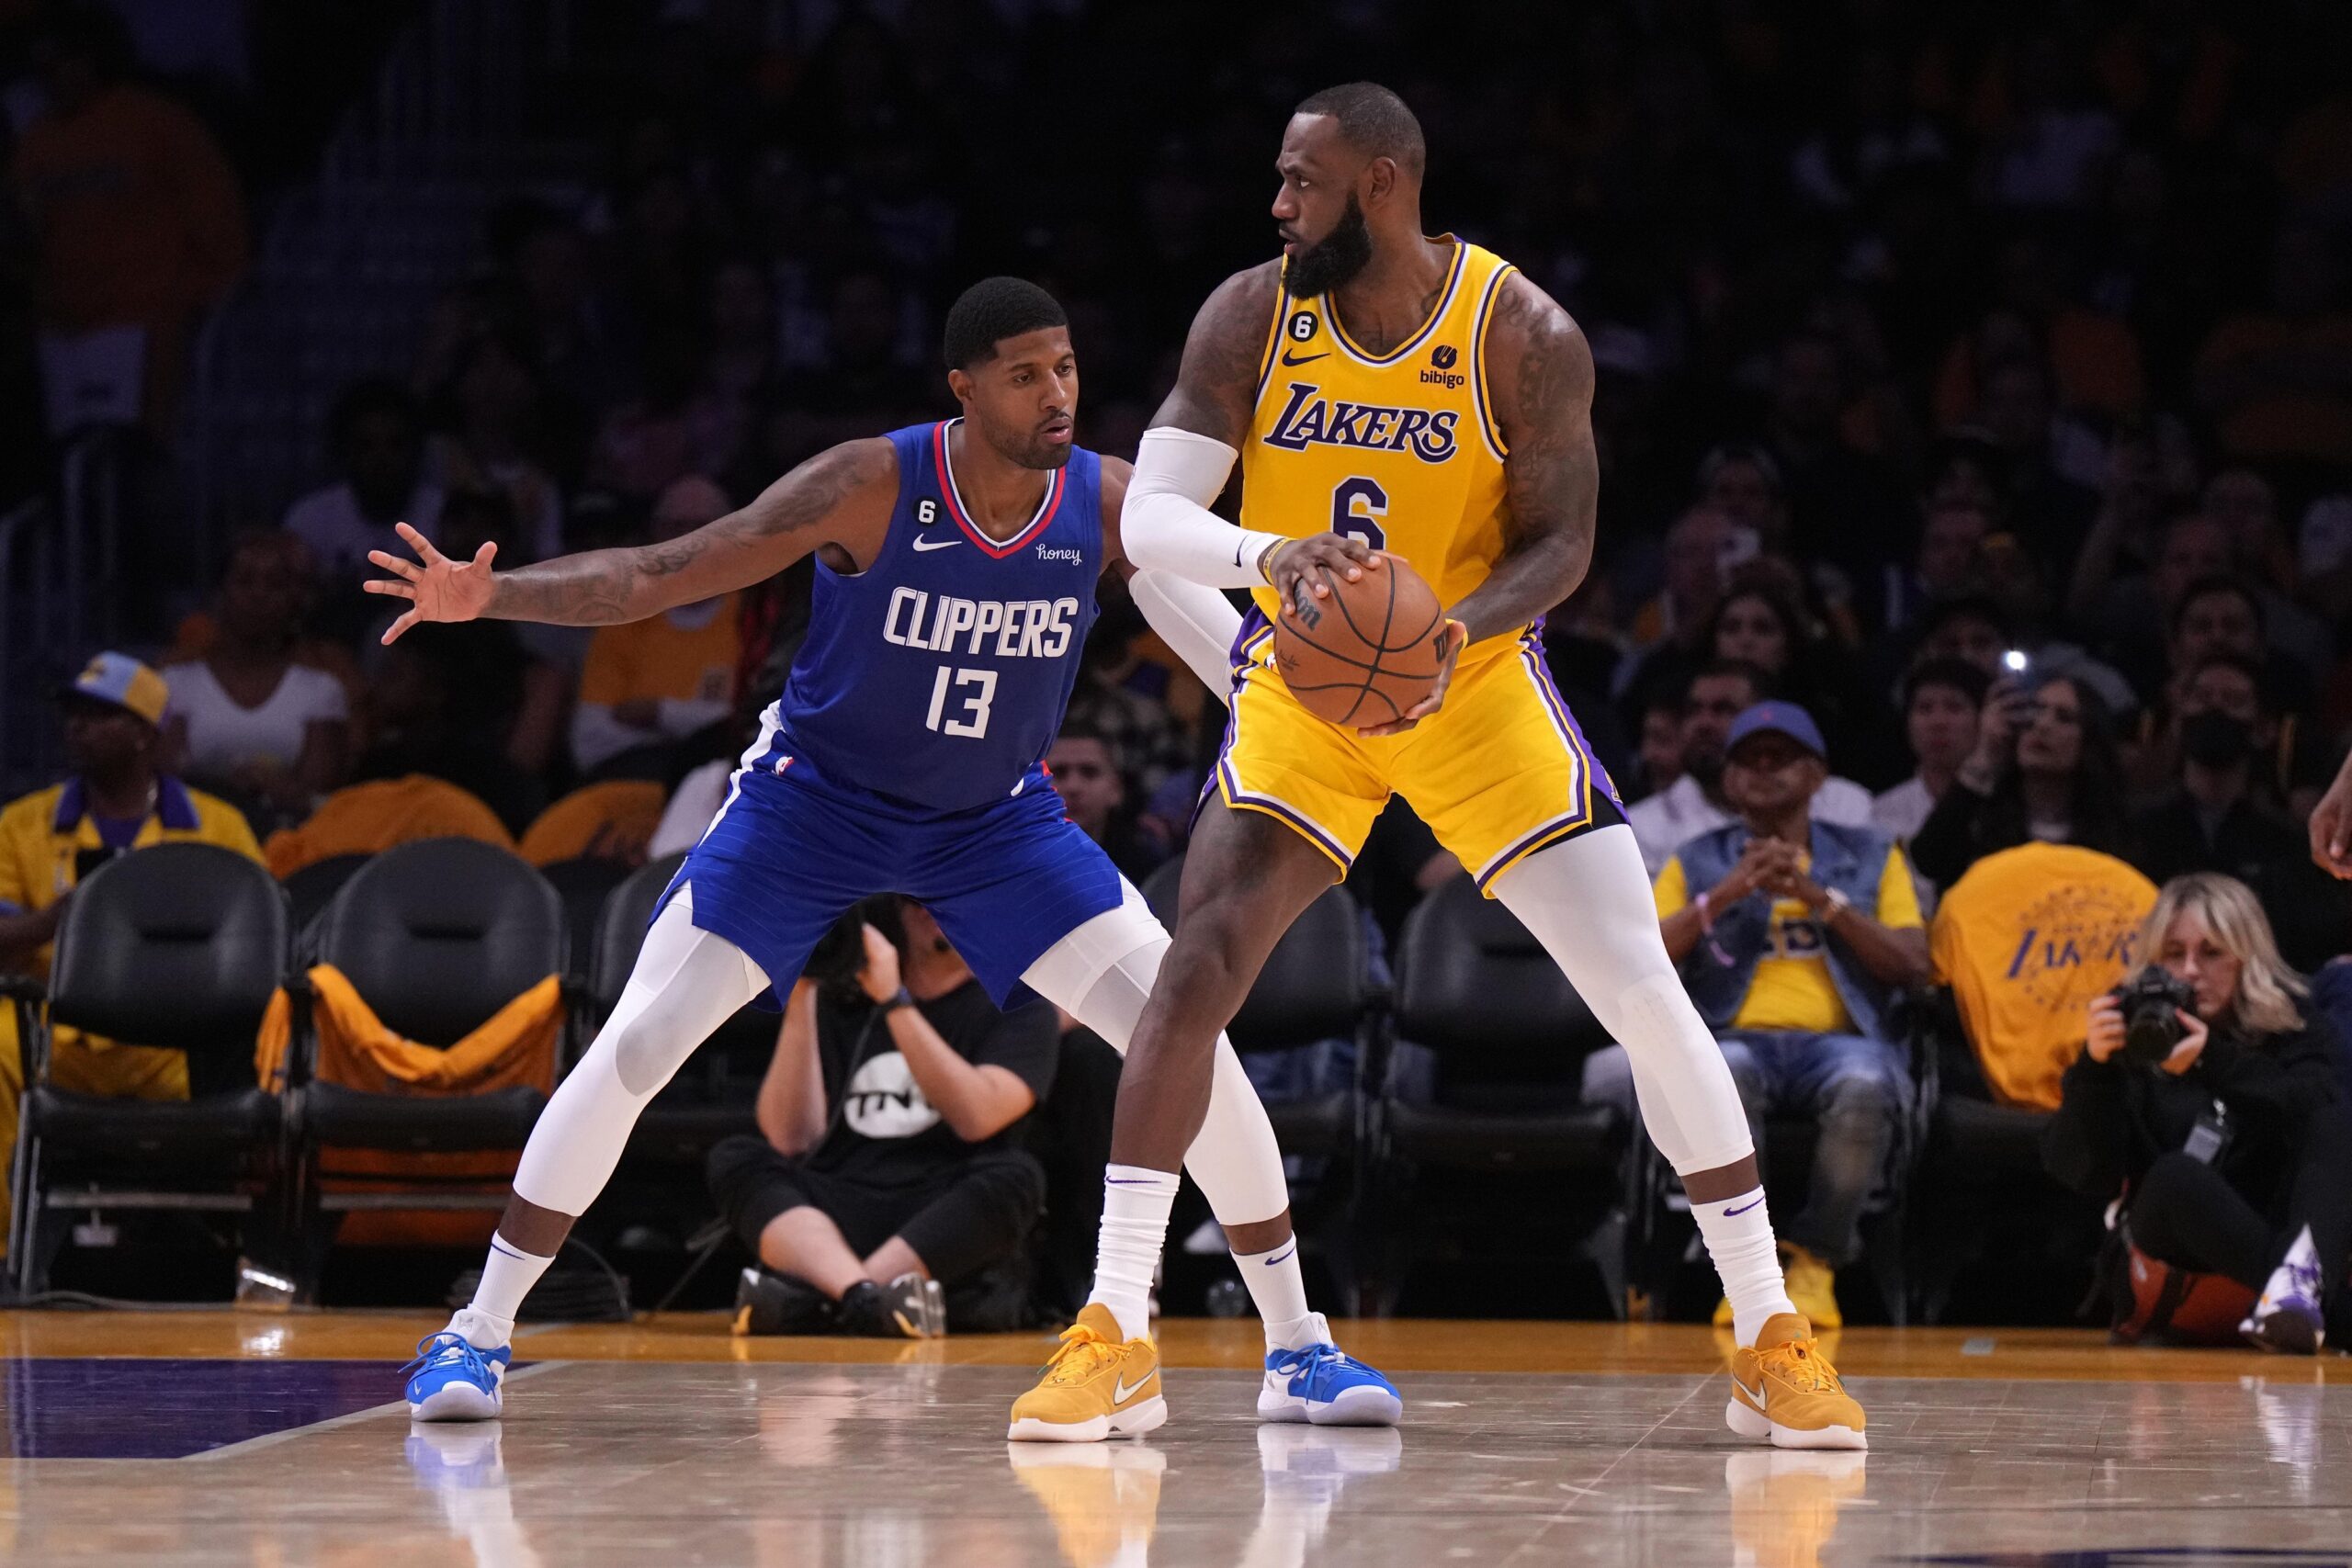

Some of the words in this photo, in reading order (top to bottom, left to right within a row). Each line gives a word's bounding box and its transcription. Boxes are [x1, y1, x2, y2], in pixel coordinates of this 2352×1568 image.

[1295, 315, 1312, 339] 6
[1419, 369, 1464, 389] bibigo
[1262, 381, 1461, 465] LAKERS
[918, 500, 936, 524] 6
[1331, 475, 1389, 550] 6
[1035, 543, 1082, 566] honey
[883, 585, 1080, 659] CLIPPERS
[925, 665, 999, 739] 13
